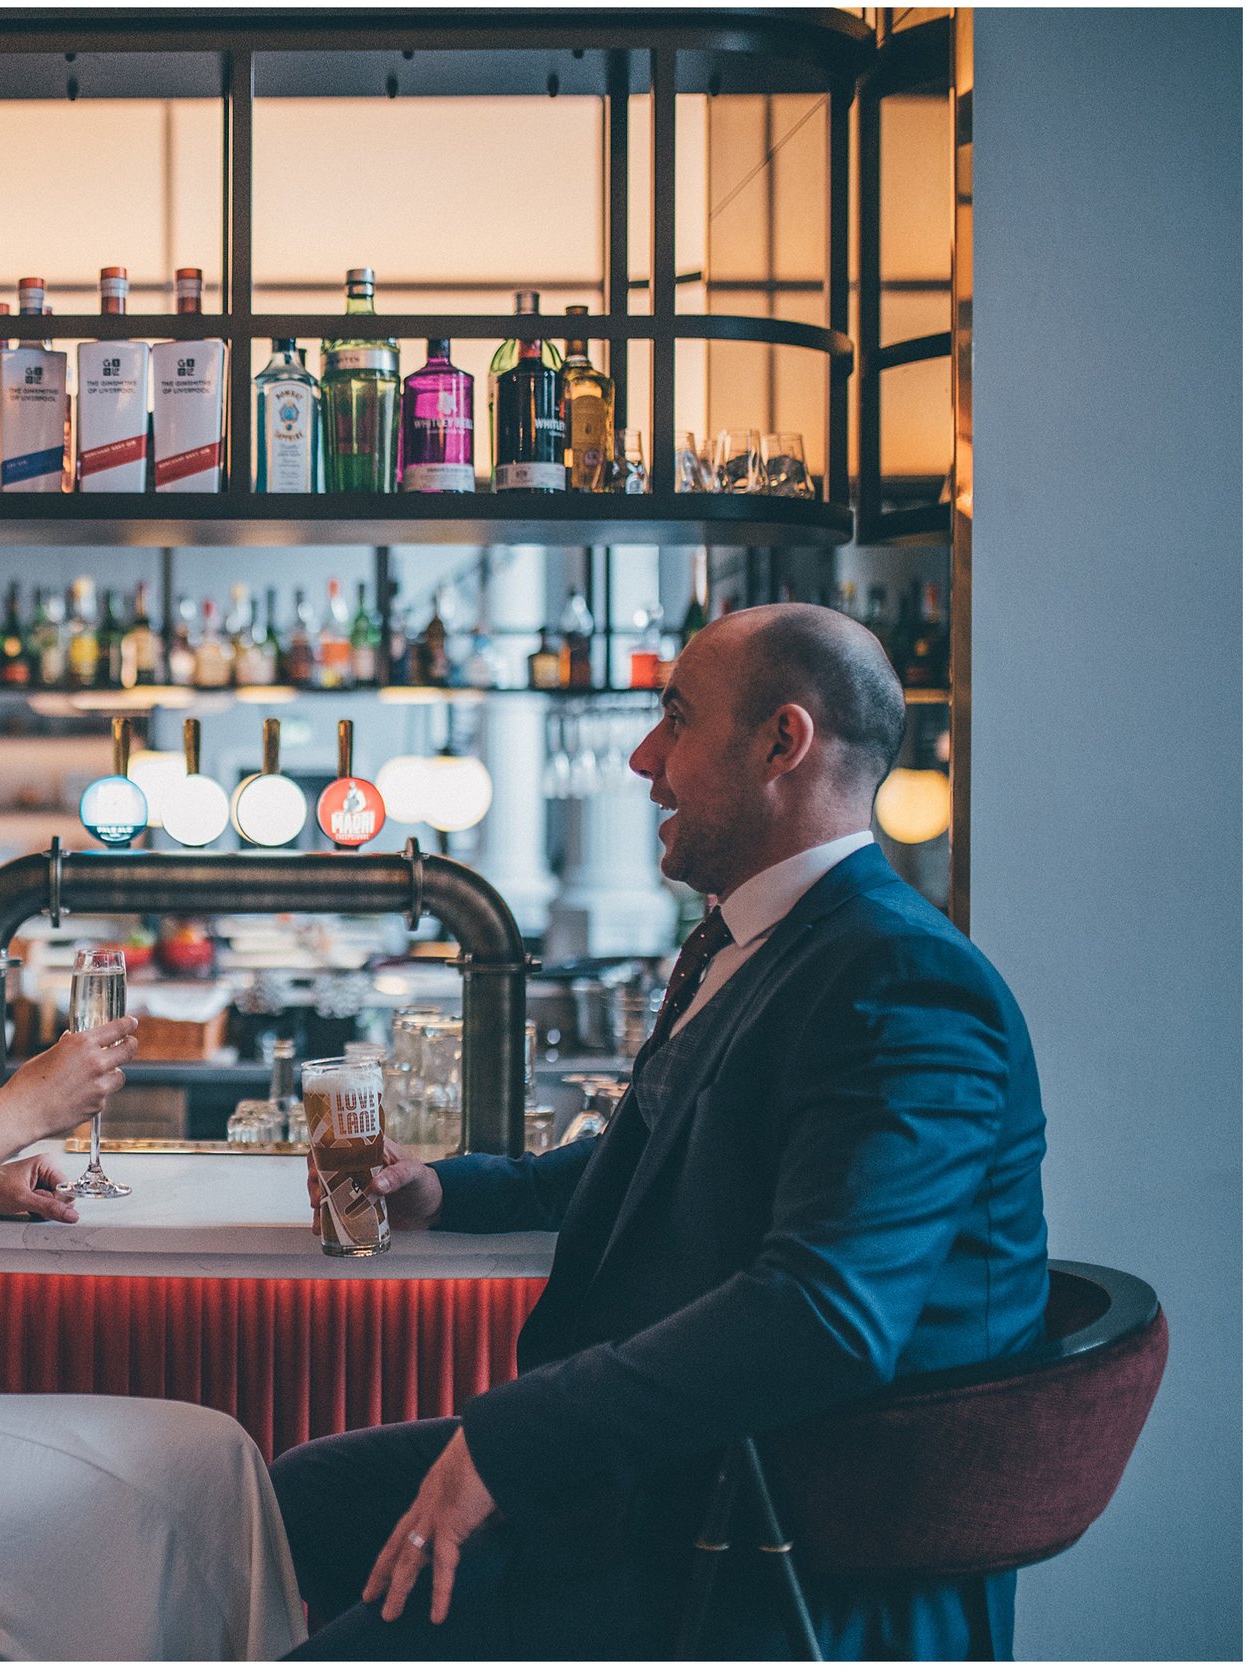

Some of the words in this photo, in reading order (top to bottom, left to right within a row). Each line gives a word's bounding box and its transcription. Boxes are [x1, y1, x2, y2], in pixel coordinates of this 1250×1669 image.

[275, 389, 303, 401] BOMBAY
[335, 1086, 375, 1111] LOVE
[337, 1109, 376, 1136] LANE
